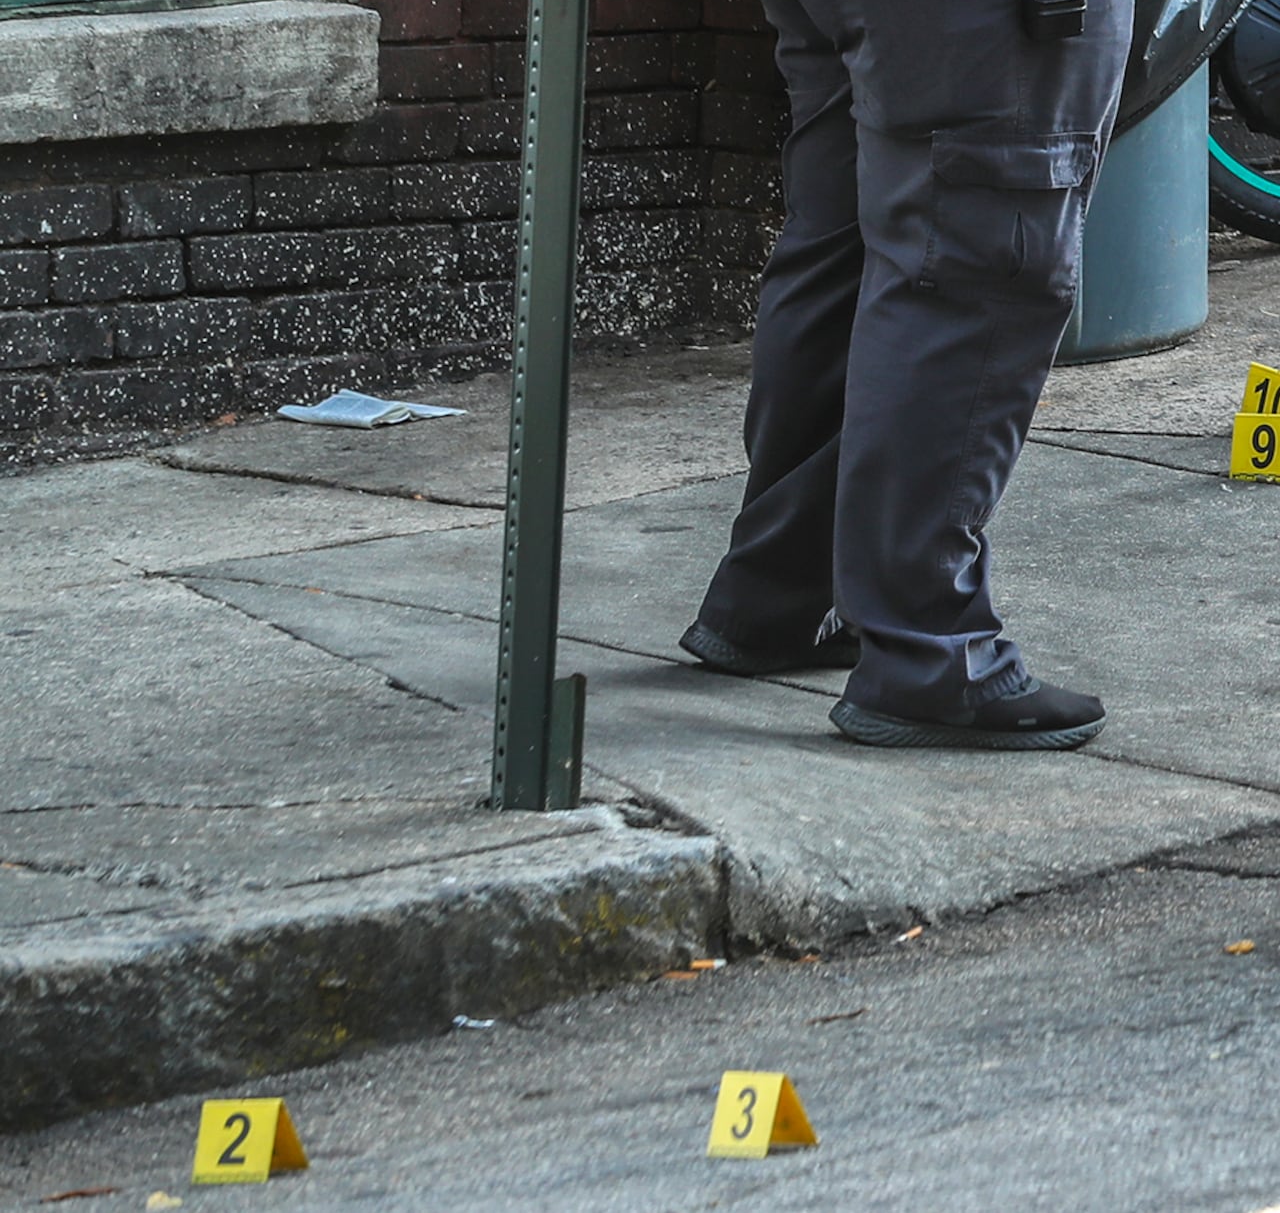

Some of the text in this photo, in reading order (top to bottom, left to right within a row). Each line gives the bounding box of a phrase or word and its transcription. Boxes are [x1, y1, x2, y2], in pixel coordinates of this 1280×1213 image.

[1250, 424, 1277, 470] 9
[216, 1112, 253, 1165] 2
[730, 1086, 759, 1141] 3
